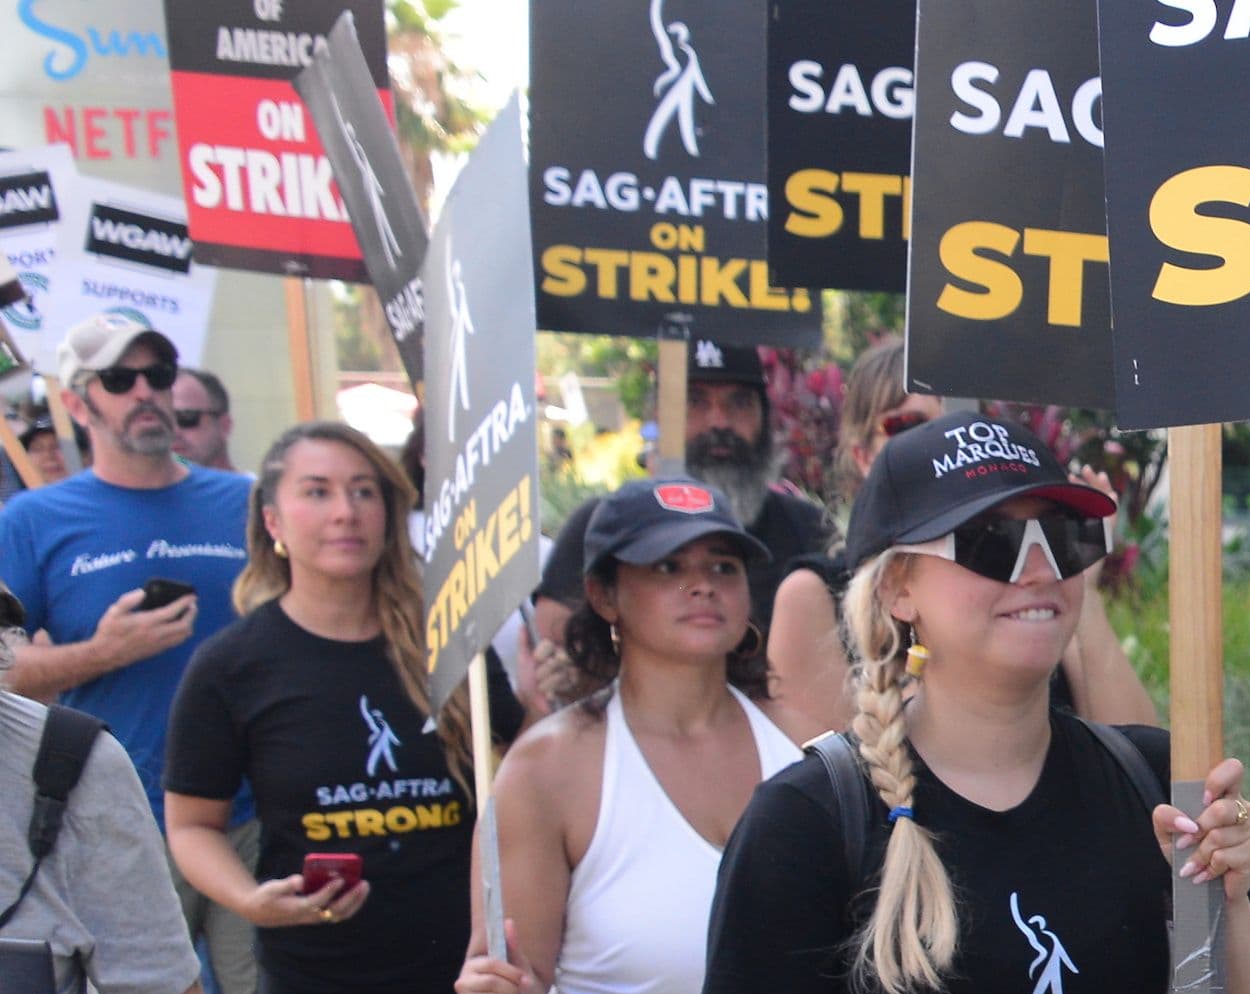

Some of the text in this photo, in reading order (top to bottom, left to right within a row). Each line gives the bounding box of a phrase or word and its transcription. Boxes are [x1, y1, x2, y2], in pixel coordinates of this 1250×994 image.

[256, 100, 305, 142] ON
[189, 143, 351, 222] STRIK
[784, 168, 911, 240] ST
[89, 216, 193, 260] WGAW
[649, 222, 705, 252] ON
[81, 277, 180, 315] SUPPORTS
[945, 421, 1009, 448] TOP
[932, 440, 1041, 478] MARQUES
[965, 463, 1028, 479] MONACO
[453, 497, 478, 550] ON
[426, 473, 532, 674] STRIKE!
[301, 801, 461, 842] STRONG
